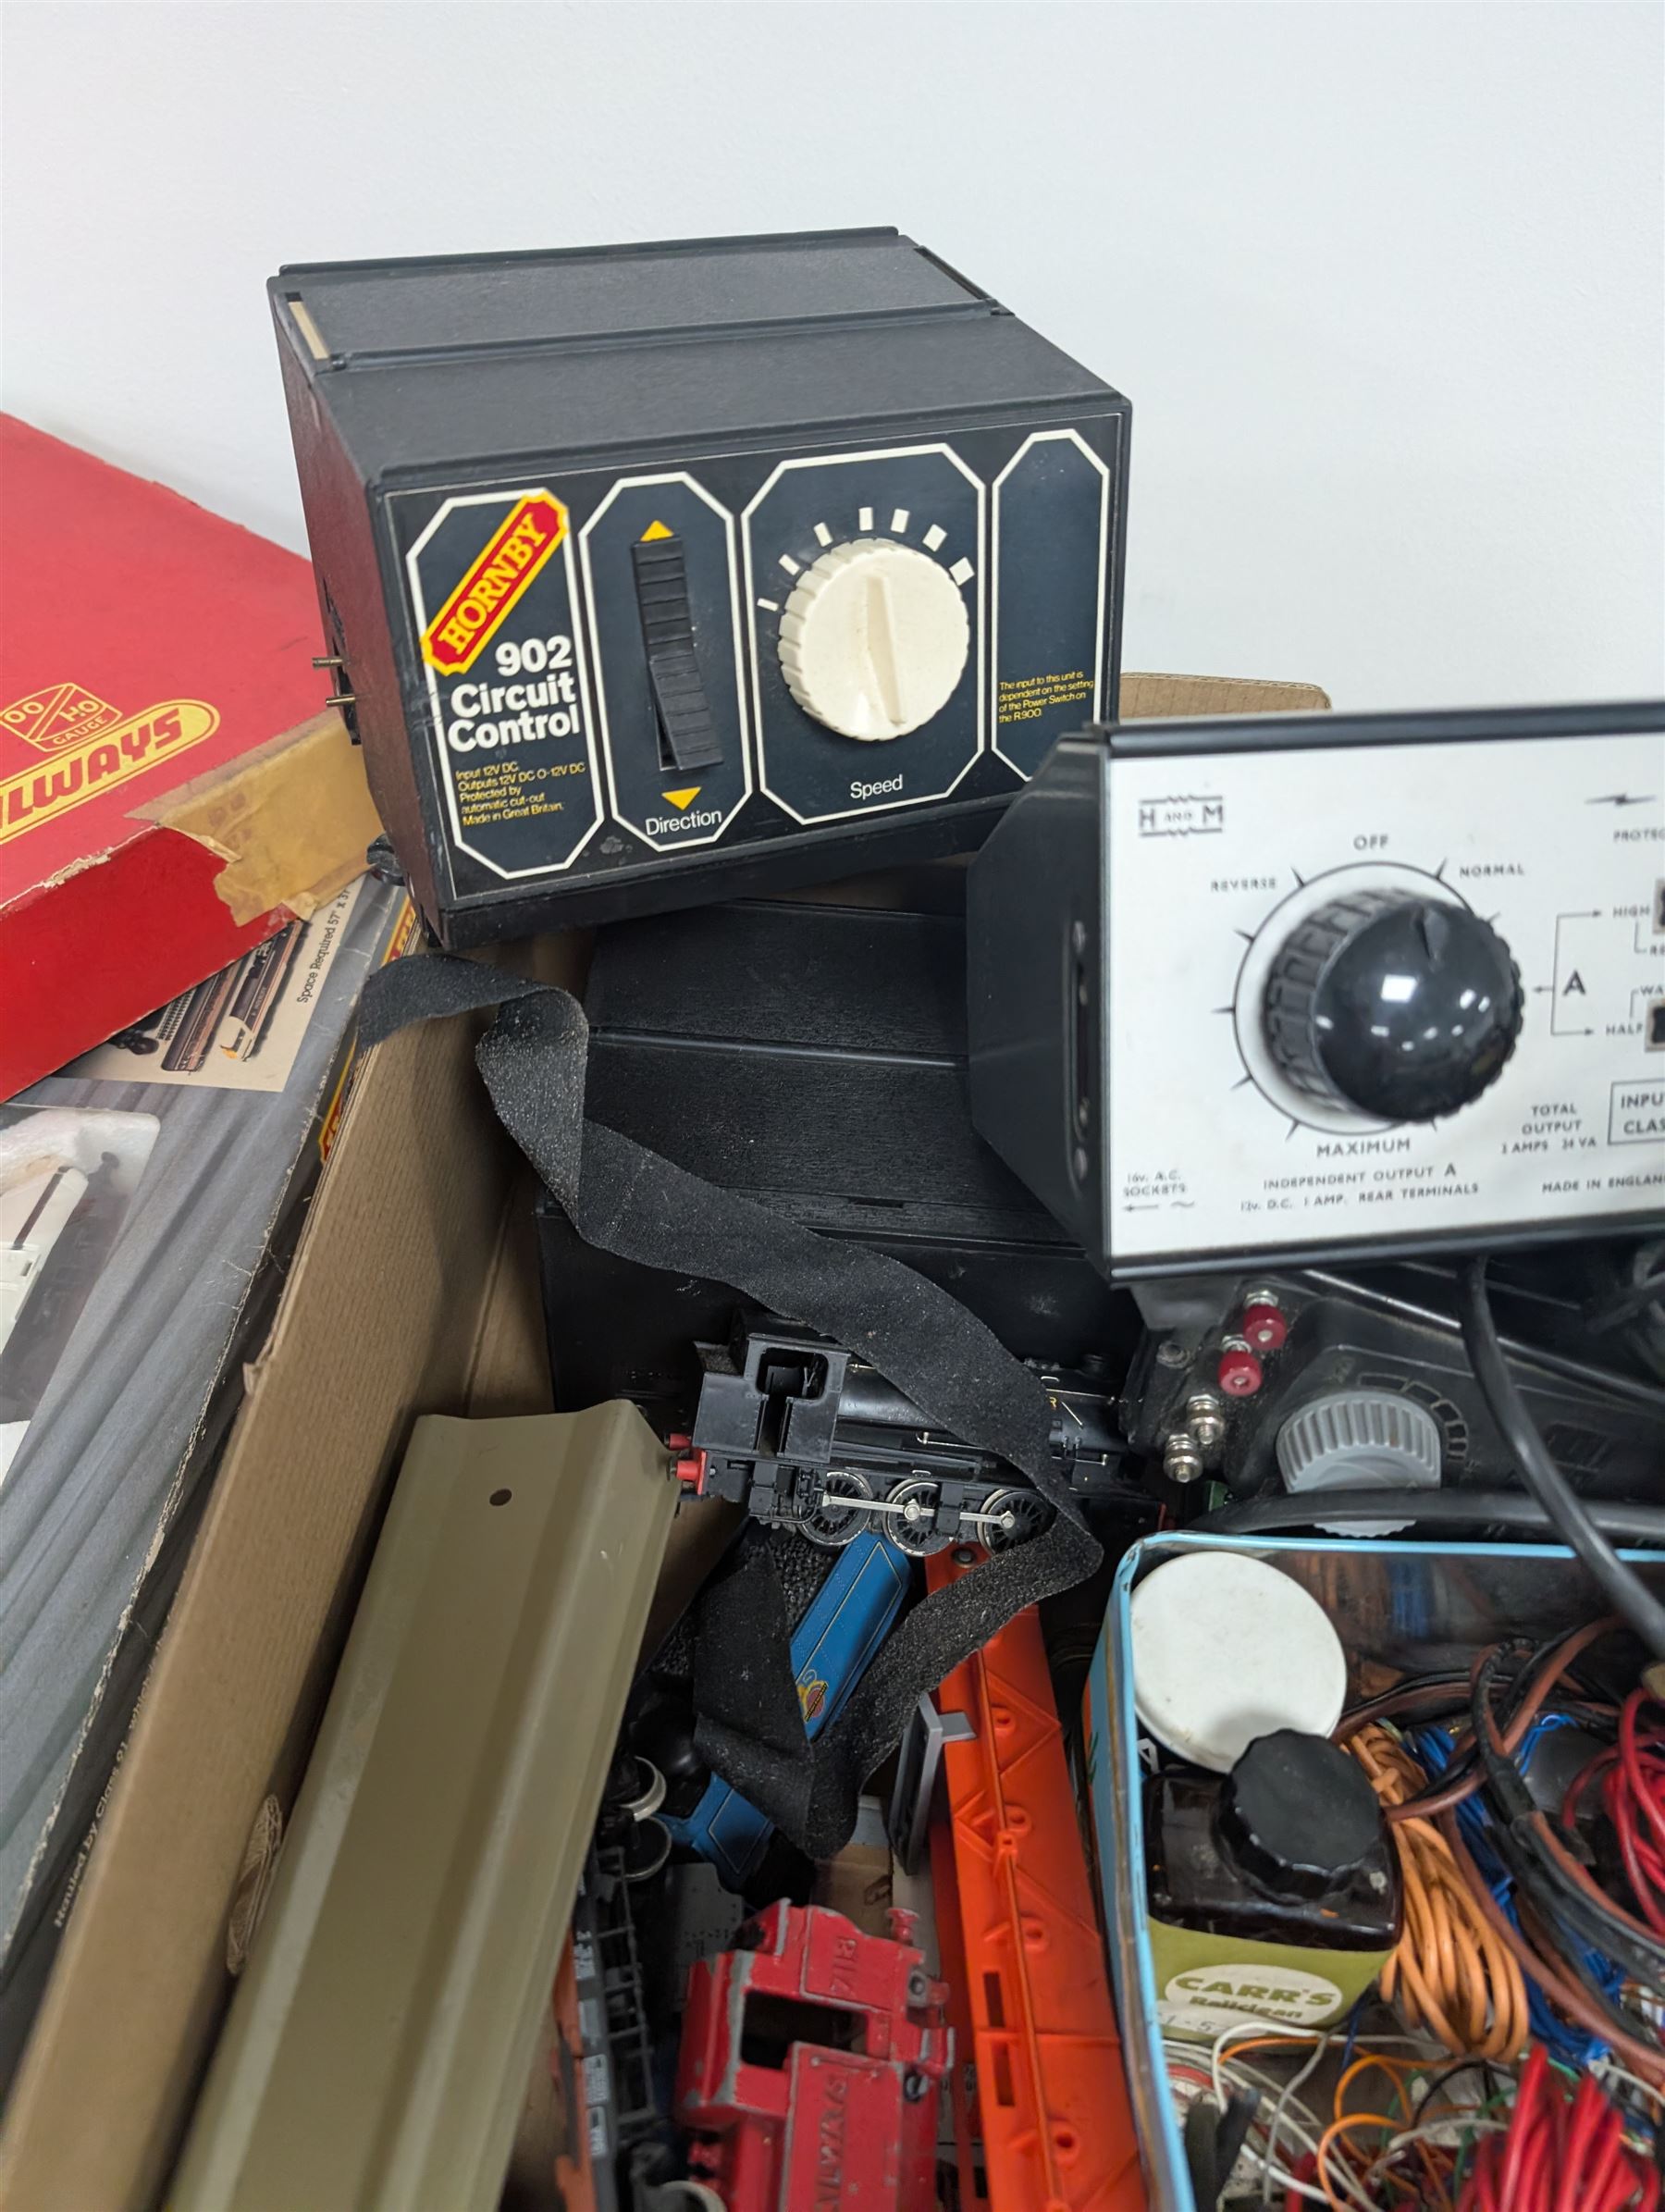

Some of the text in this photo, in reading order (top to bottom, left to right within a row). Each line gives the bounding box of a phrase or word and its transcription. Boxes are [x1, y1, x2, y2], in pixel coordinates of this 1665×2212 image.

[437, 513, 547, 655] HORNBY
[496, 636, 573, 676] 902
[999, 687, 1041, 702] dependent
[1054, 684, 1067, 692] the
[1067, 680, 1094, 690] setting
[1000, 682, 1015, 690] The
[1017, 677, 1035, 688] input
[1046, 673, 1060, 683] this
[1061, 672, 1076, 681] unit
[451, 672, 576, 718] Circuit
[999, 704, 1007, 713] of
[1008, 701, 1022, 711] the
[1022, 698, 1047, 709] Power
[1048, 692, 1075, 704] Switch
[448, 704, 580, 751] Control
[999, 713, 1012, 723] the
[53, 715, 107, 745] GAUGE
[456, 761, 519, 781] Input 12V DC
[458, 777, 498, 791] Outputs
[500, 774, 516, 785] 12V
[519, 771, 535, 783] DC
[569, 761, 586, 774] DC
[460, 786, 522, 803] Protected by
[850, 774, 903, 800] Speed
[462, 793, 545, 814] automatic cut-out
[463, 814, 490, 826] Made
[492, 811, 501, 820] in
[502, 807, 529, 820] Great
[647, 809, 722, 835] Direction
[1139, 805, 1223, 828] H AND M
[1353, 834, 1388, 850] OFF
[1460, 863, 1525, 878] NORMAL
[1211, 878, 1276, 892] REVERSE
[1612, 906, 1650, 918] HIGH
[297, 971, 318, 1003] Space
[310, 925, 336, 970] Required
[1563, 970, 1585, 996] A
[1606, 1022, 1643, 1035] HALF
[1531, 1103, 1577, 1117] TOTAL
[1522, 1119, 1581, 1136] OUTPUT
[1316, 1138, 1411, 1158] MAXIMUM
[1511, 1141, 1548, 1154] AMPS
[1579, 1137, 1597, 1148] VA
[1264, 1163, 1457, 1191] INDEPENDENT OUTPUT A
[1542, 1174, 1665, 1193] MADE IN ENGLAN
[1123, 1183, 1187, 1197] SOCKETS
[1358, 1191, 1394, 1203] REAR
[1400, 1182, 1479, 1200] TERMINALS
[55, 1851, 86, 1928] Hauled
[83, 1822, 98, 1849] by
[95, 1766, 119, 1818] Class
[1175, 1977, 1336, 2007] CARR'S
